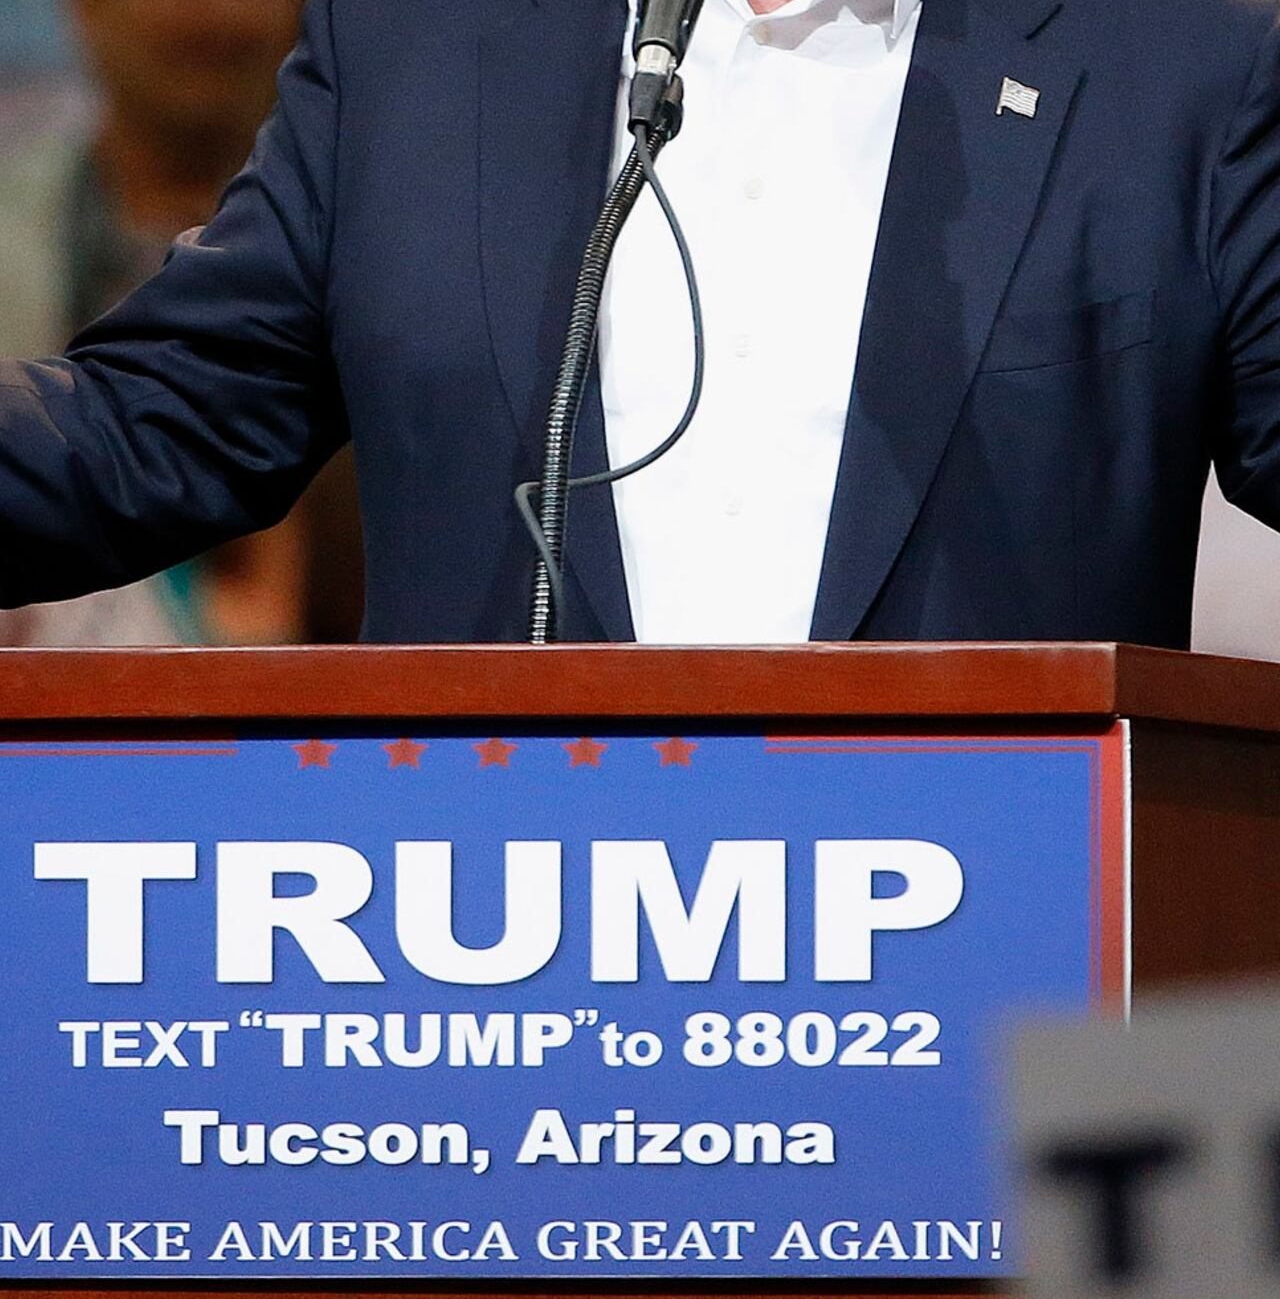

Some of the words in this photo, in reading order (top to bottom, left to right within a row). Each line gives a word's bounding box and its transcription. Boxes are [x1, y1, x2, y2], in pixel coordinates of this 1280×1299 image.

[33, 839, 964, 986] TRUMP
[58, 1020, 230, 1069] TEXT
[600, 1028, 663, 1068] to
[682, 1011, 941, 1068] 88022
[163, 1110, 489, 1174] Tucson,
[515, 1108, 836, 1166] Arizona
[0, 1221, 191, 1262] MAKE
[207, 1220, 519, 1262] AMERICA
[537, 1220, 755, 1262] GREAT
[769, 1219, 1003, 1262] AGAIN!
